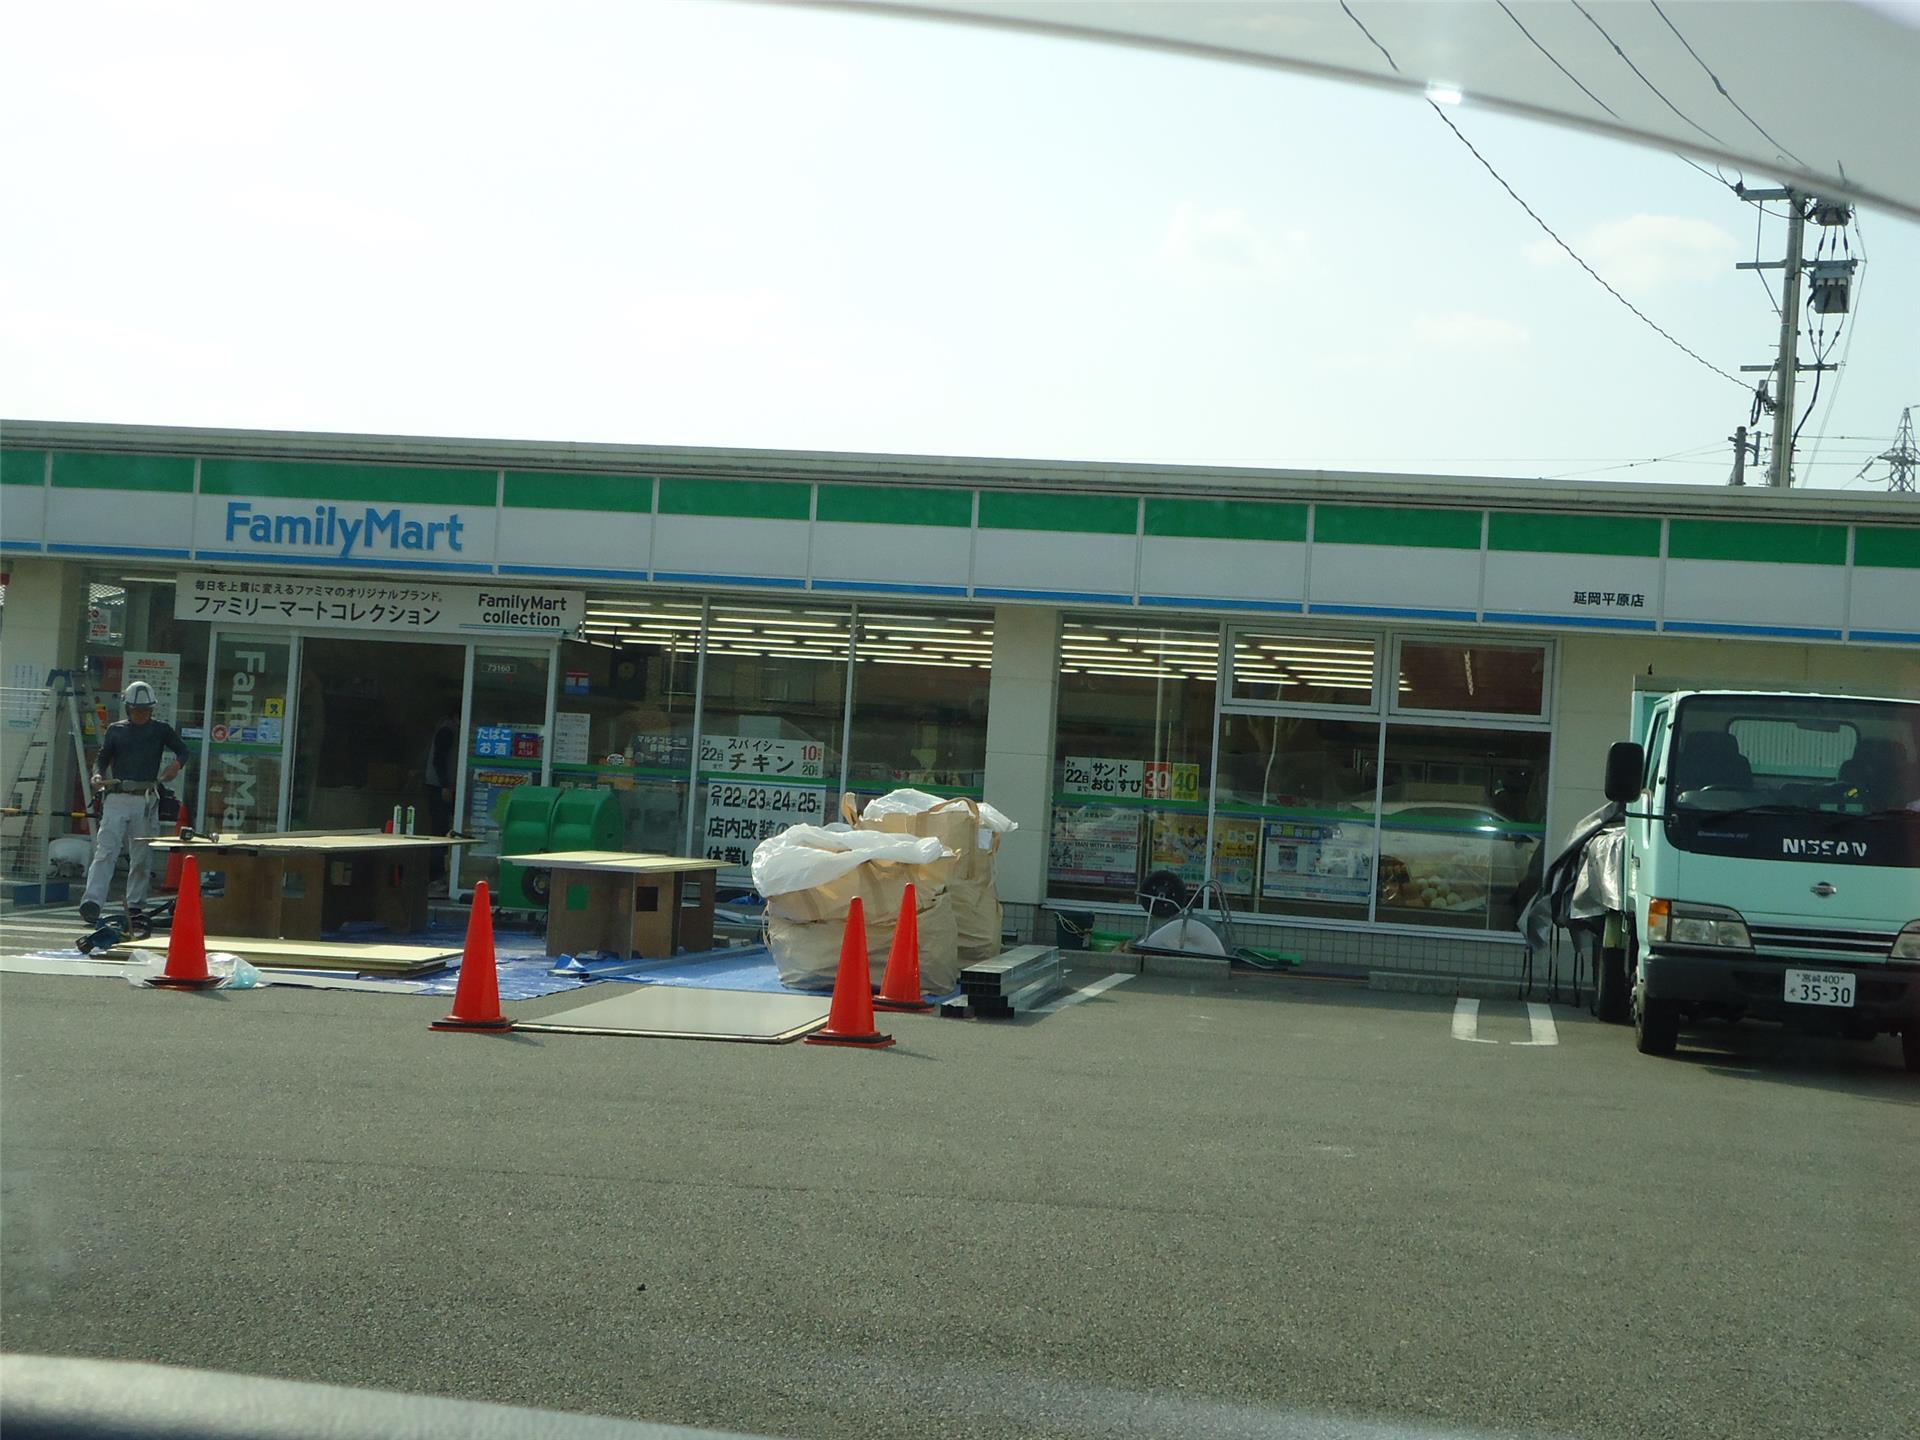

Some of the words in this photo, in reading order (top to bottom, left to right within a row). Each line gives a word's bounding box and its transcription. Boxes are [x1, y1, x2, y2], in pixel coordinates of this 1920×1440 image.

[226, 502, 464, 558] FamilyMart
[478, 593, 567, 612] FamilyMart
[1573, 591, 1645, 607] 延岡平原店
[194, 597, 441, 625] ファミリーマートコレクション
[482, 610, 560, 627] collection
[477, 728, 511, 740] たばこ
[480, 742, 507, 755] お酒
[729, 753, 794, 773] チキン
[1093, 763, 1129, 777] サンド
[1091, 777, 1142, 792] おむすび
[1782, 838, 1867, 857] NISSAN
[1822, 975, 1840, 984] 400
[1800, 984, 1850, 1004] 35-30
